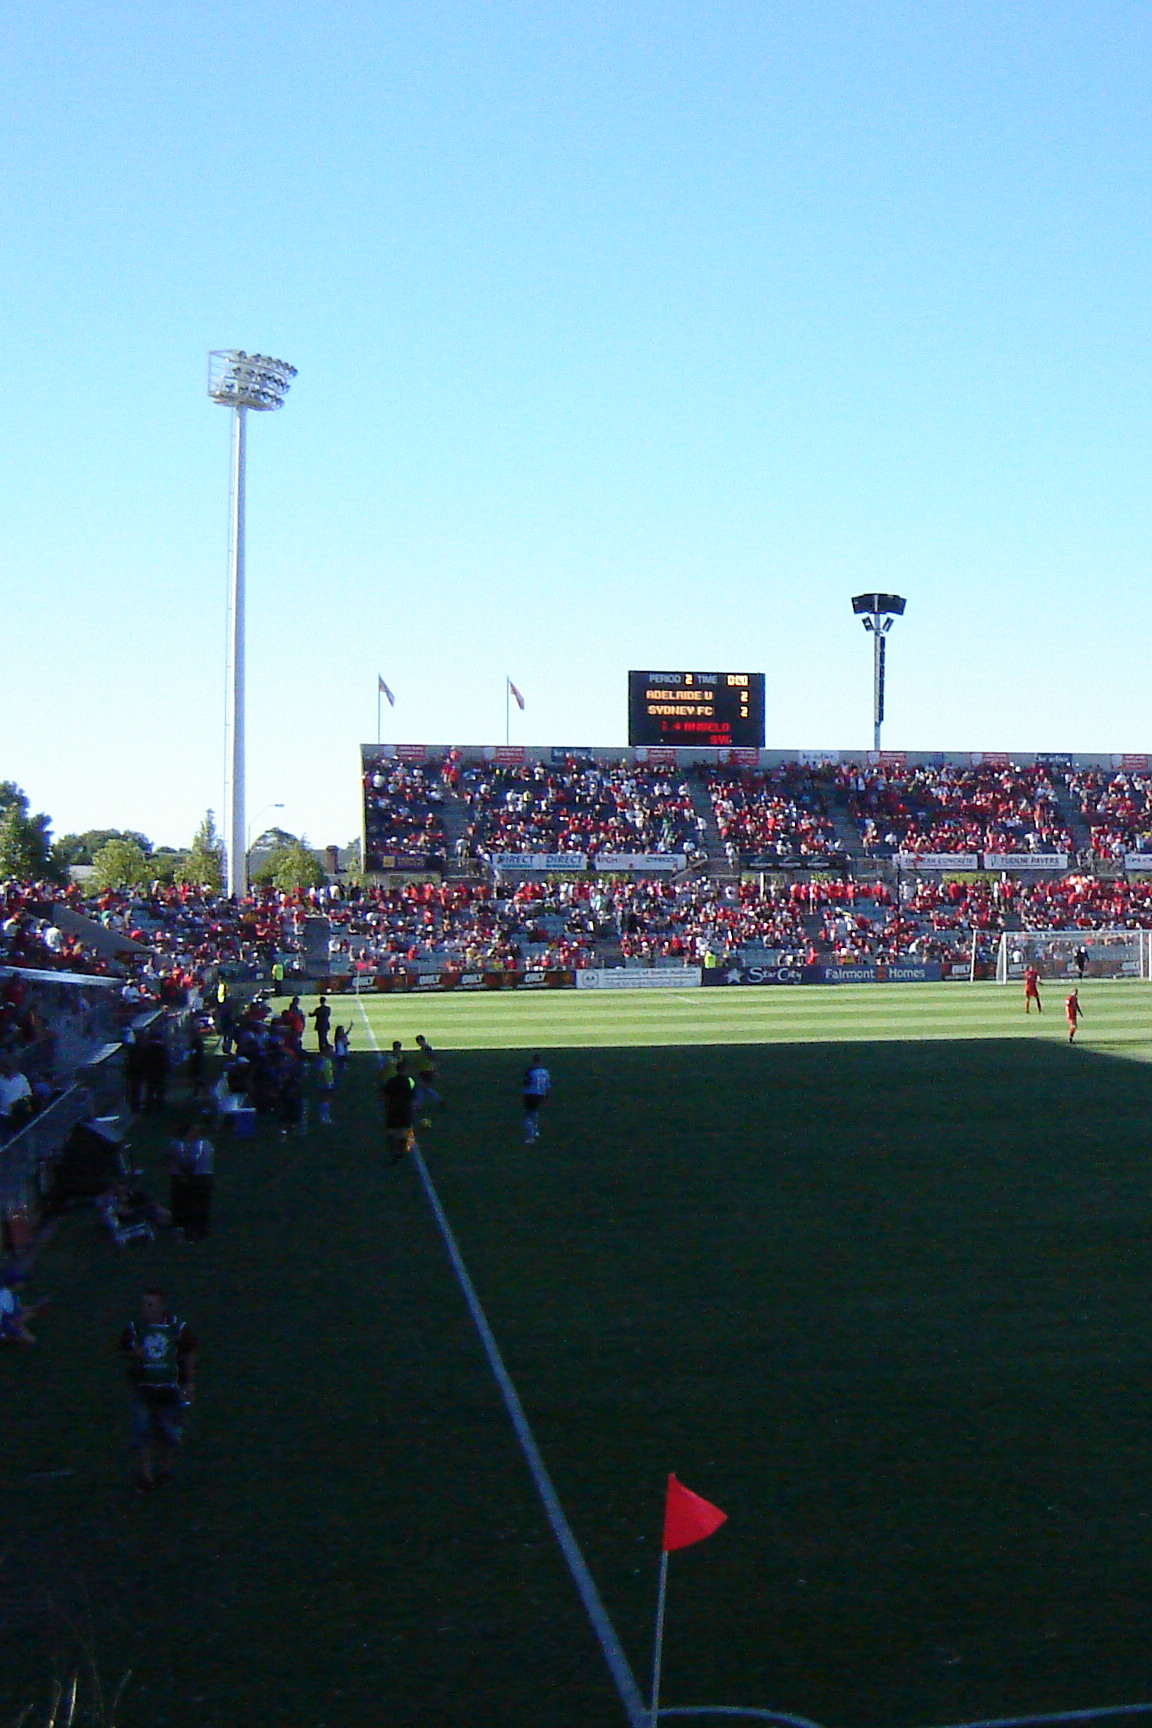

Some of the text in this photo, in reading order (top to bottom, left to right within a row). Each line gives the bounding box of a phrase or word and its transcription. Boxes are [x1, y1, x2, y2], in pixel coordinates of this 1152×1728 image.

[649, 674, 681, 684] PERIOD
[685, 674, 693, 685] 2
[698, 675, 718, 684] TIME
[646, 690, 749, 702] ADELAIDE U 2
[648, 704, 749, 717] SYDNEY FC 2
[498, 855, 535, 864] DIRECT
[546, 855, 583, 864] DIRECT
[825, 967, 926, 979] Fairmont Homes
